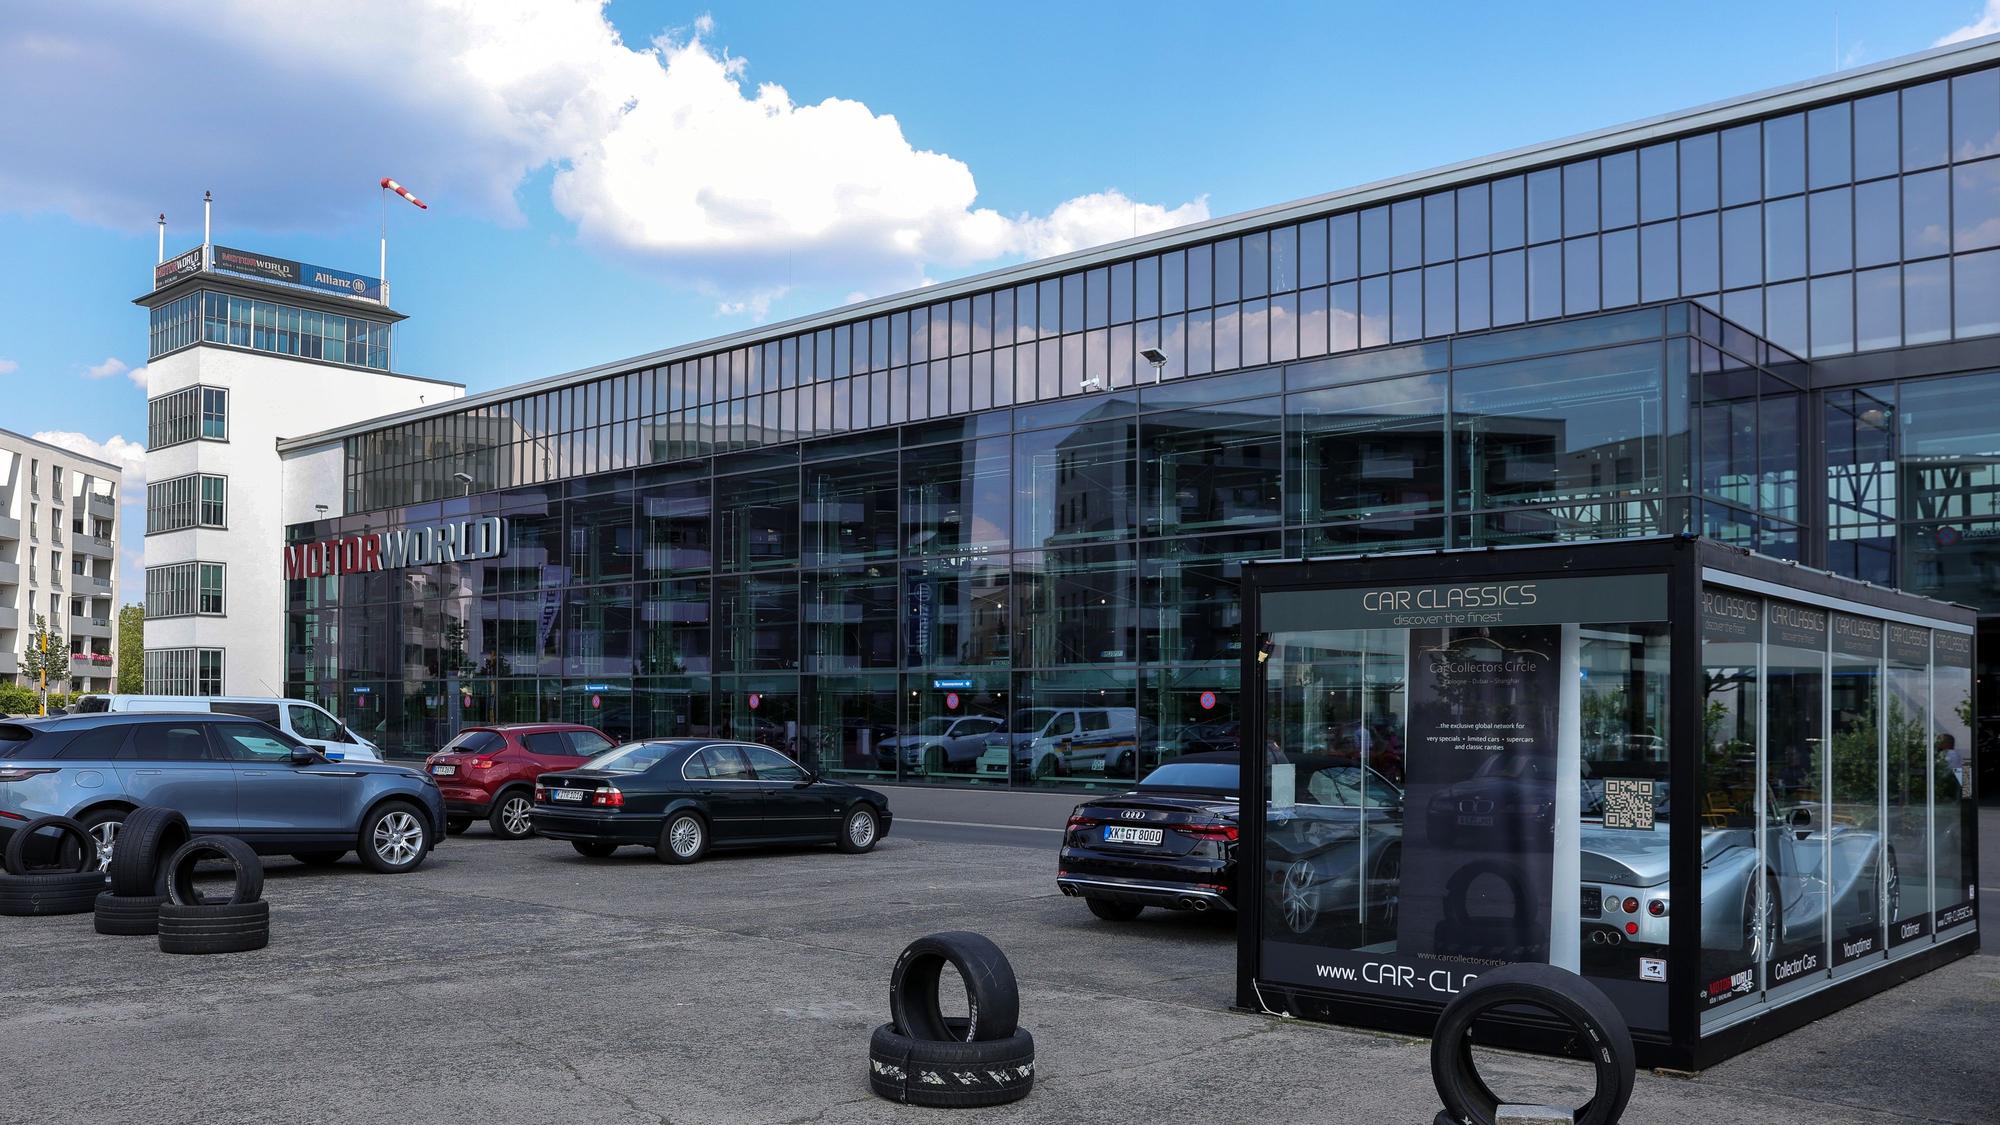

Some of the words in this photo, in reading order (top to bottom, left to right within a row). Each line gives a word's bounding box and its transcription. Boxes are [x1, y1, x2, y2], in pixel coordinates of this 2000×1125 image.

[222, 252, 291, 274] MOTORWORLD
[315, 272, 351, 289] Allianz
[284, 517, 502, 581] MOTORWORLD
[1363, 590, 1411, 611] CAR
[1416, 584, 1537, 609] CLASSICS
[1714, 594, 1758, 621] CLASSICS
[1393, 613, 1442, 626] discover
[1444, 612, 1465, 624] the
[1467, 611, 1503, 623] finest
[1770, 605, 1788, 625] CAR
[1788, 608, 1825, 632] CLASSICS
[1504, 660, 1537, 672] Circle
[1475, 722, 1493, 731] global
[1439, 735, 1461, 743] specials
[1125, 828, 1138, 841] GT
[1138, 830, 1162, 842] 8000
[1900, 922, 1920, 940] Oldtimer
[1843, 937, 1872, 958] Youngtimer
[1774, 958, 1803, 981] Collector
[1802, 953, 1817, 970] Cars
[1708, 968, 1753, 995] MOTORWORLD
